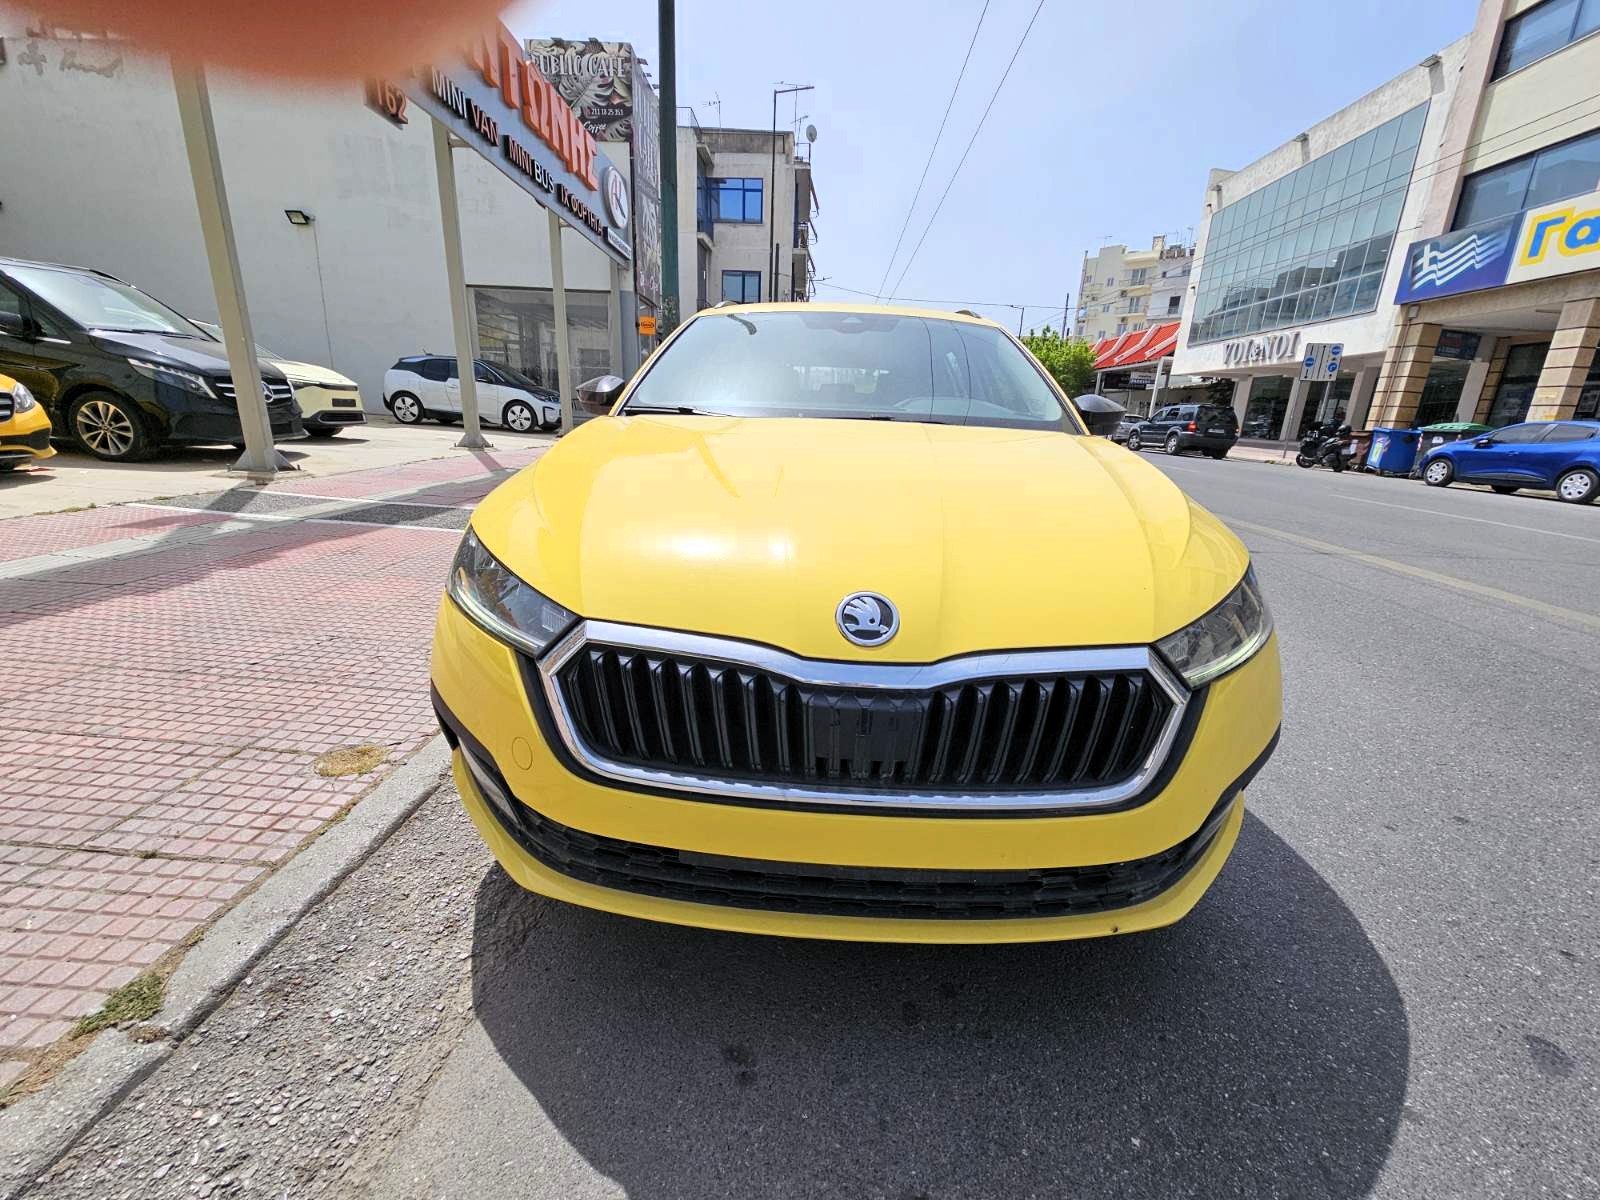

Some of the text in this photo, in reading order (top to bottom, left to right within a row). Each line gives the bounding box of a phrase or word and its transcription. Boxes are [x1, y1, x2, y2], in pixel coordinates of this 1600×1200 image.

[431, 65, 555, 193] MINI VAN MINI BUS
